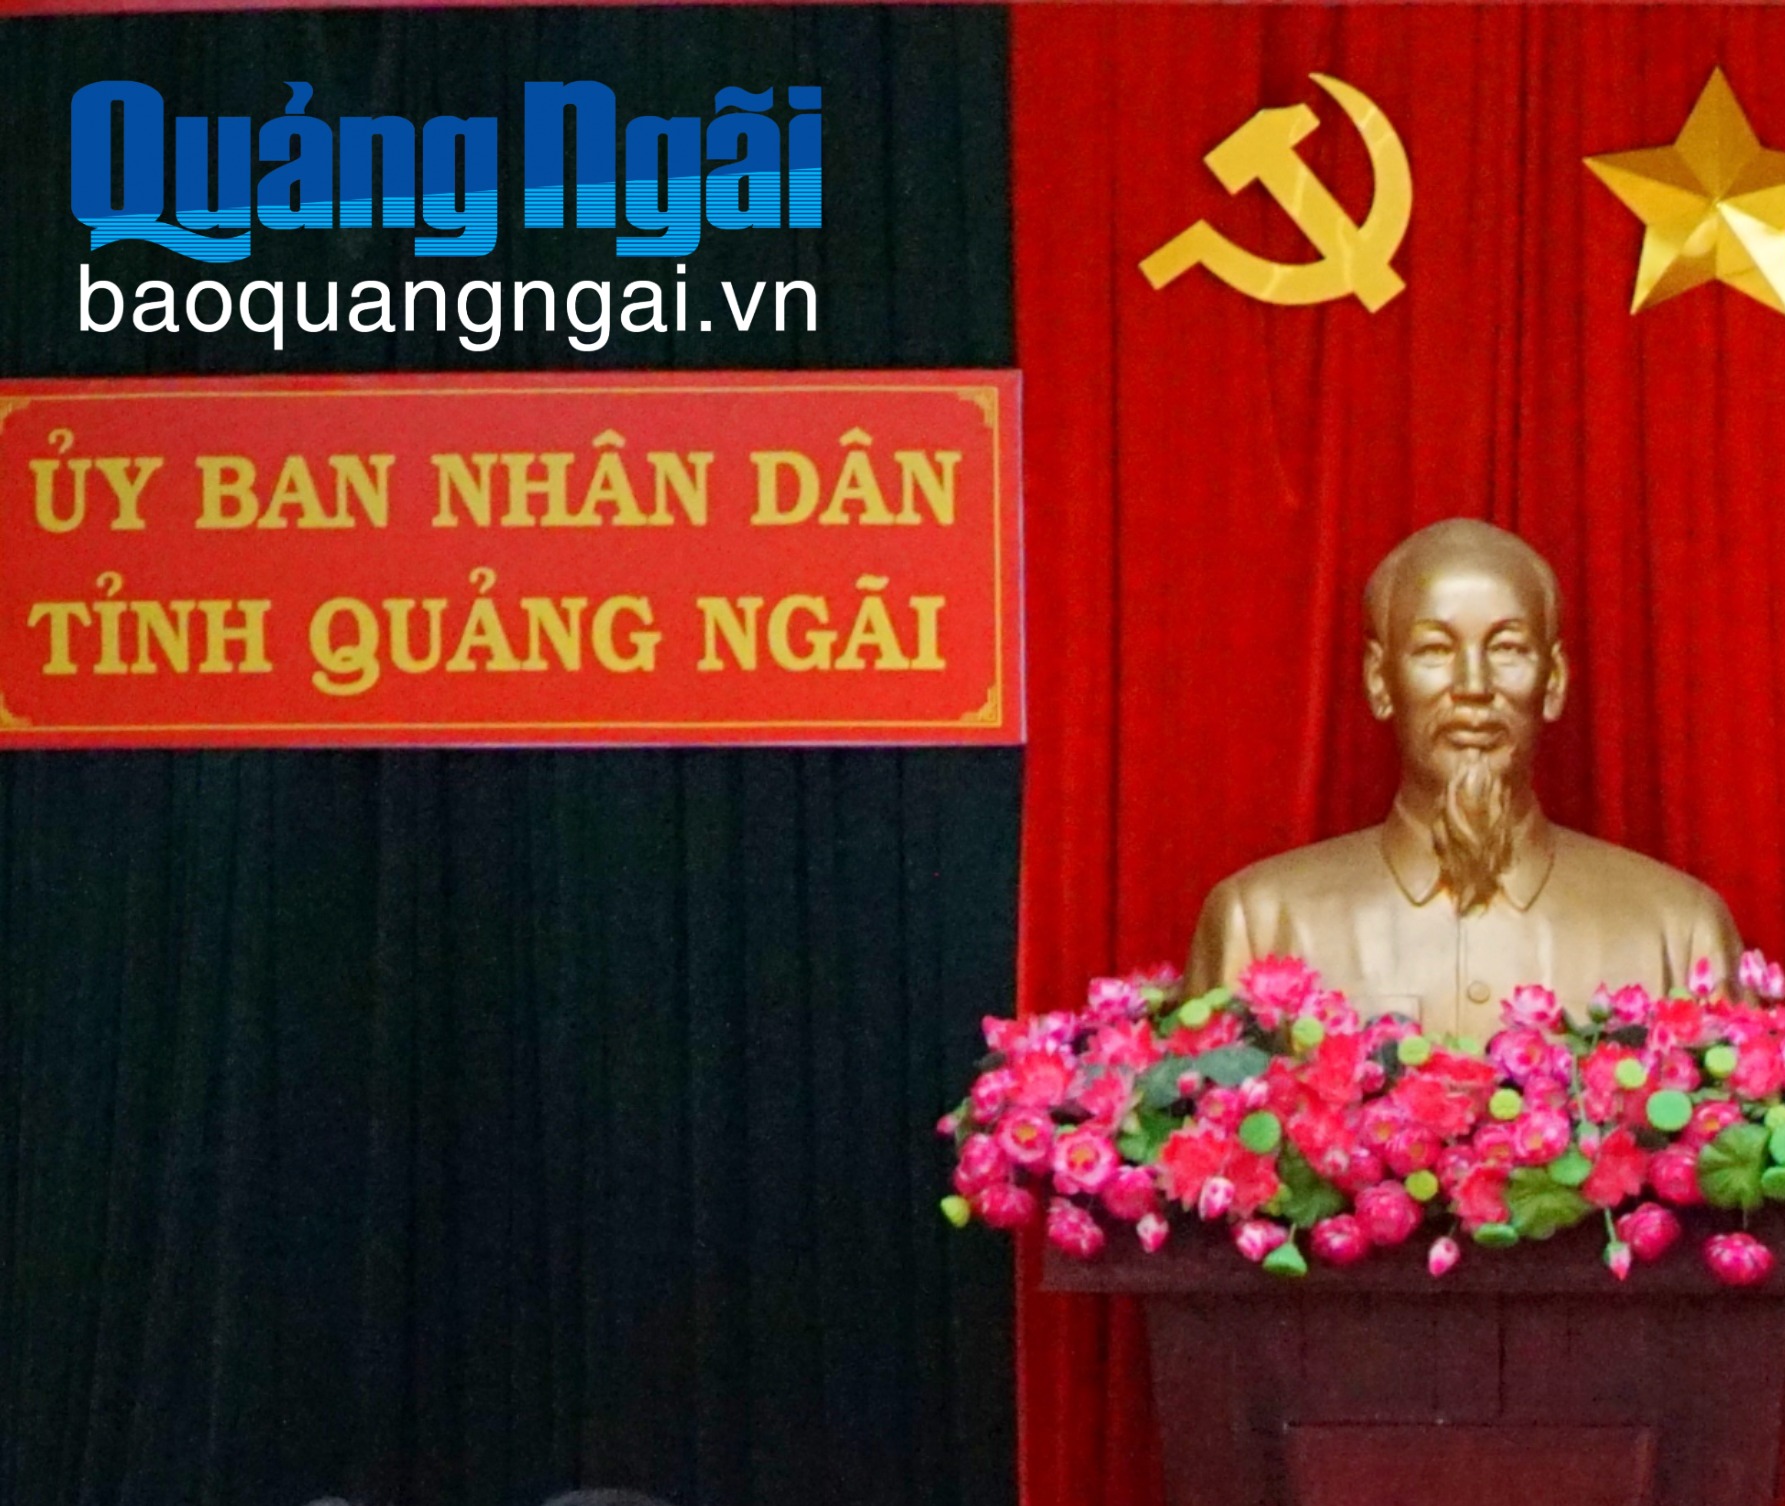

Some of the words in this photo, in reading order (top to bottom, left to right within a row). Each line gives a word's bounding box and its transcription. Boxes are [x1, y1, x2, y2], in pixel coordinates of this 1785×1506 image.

[30, 429, 163, 532] ỦY
[196, 455, 396, 529] BAN
[431, 429, 715, 527] NHÂN
[749, 427, 962, 526] DÂN
[29, 572, 273, 674] TỈNH
[310, 568, 662, 696] QUẢNG
[697, 575, 946, 672] NGÃI
